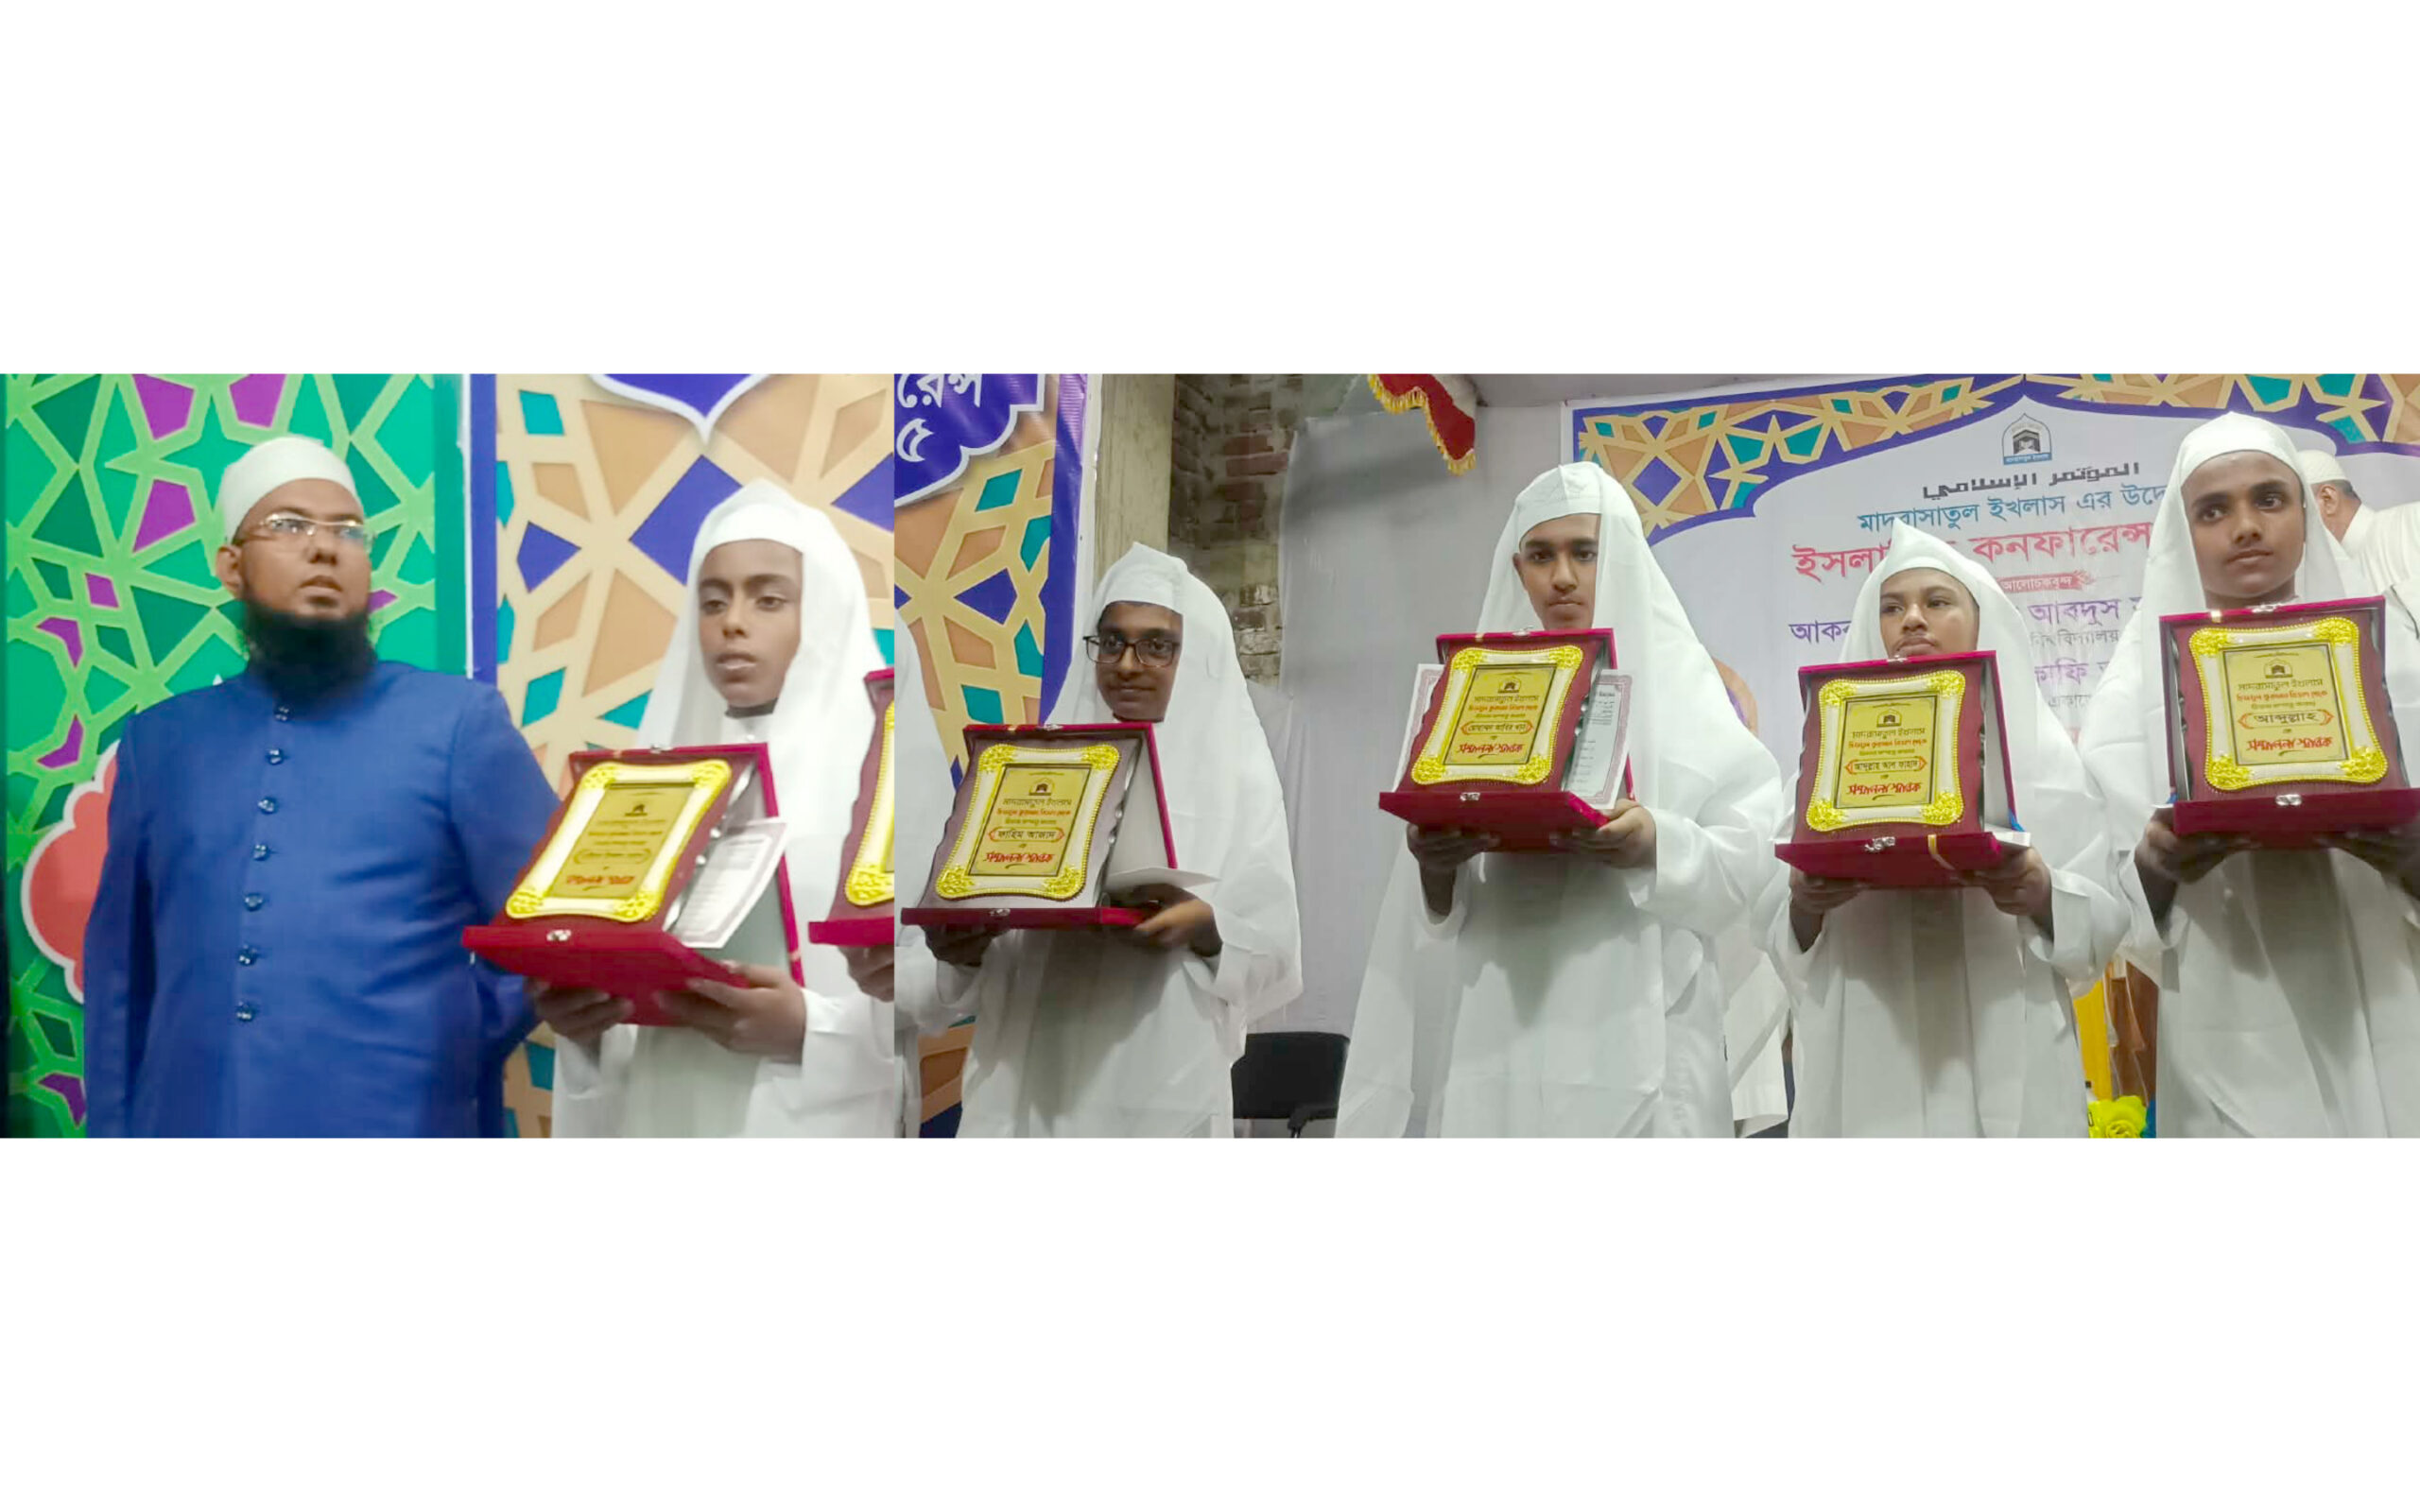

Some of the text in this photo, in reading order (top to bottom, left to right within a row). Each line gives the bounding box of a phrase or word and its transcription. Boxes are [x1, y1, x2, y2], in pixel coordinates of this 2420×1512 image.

[1923, 472, 2037, 500] الإسلامي
[1987, 496, 2066, 522] ইখলাস
[2077, 490, 2112, 510] এর
[1968, 522, 2152, 562] কনফারেন্স
[2027, 597, 2121, 627] আবদুস
[1788, 619, 1852, 644] আক
